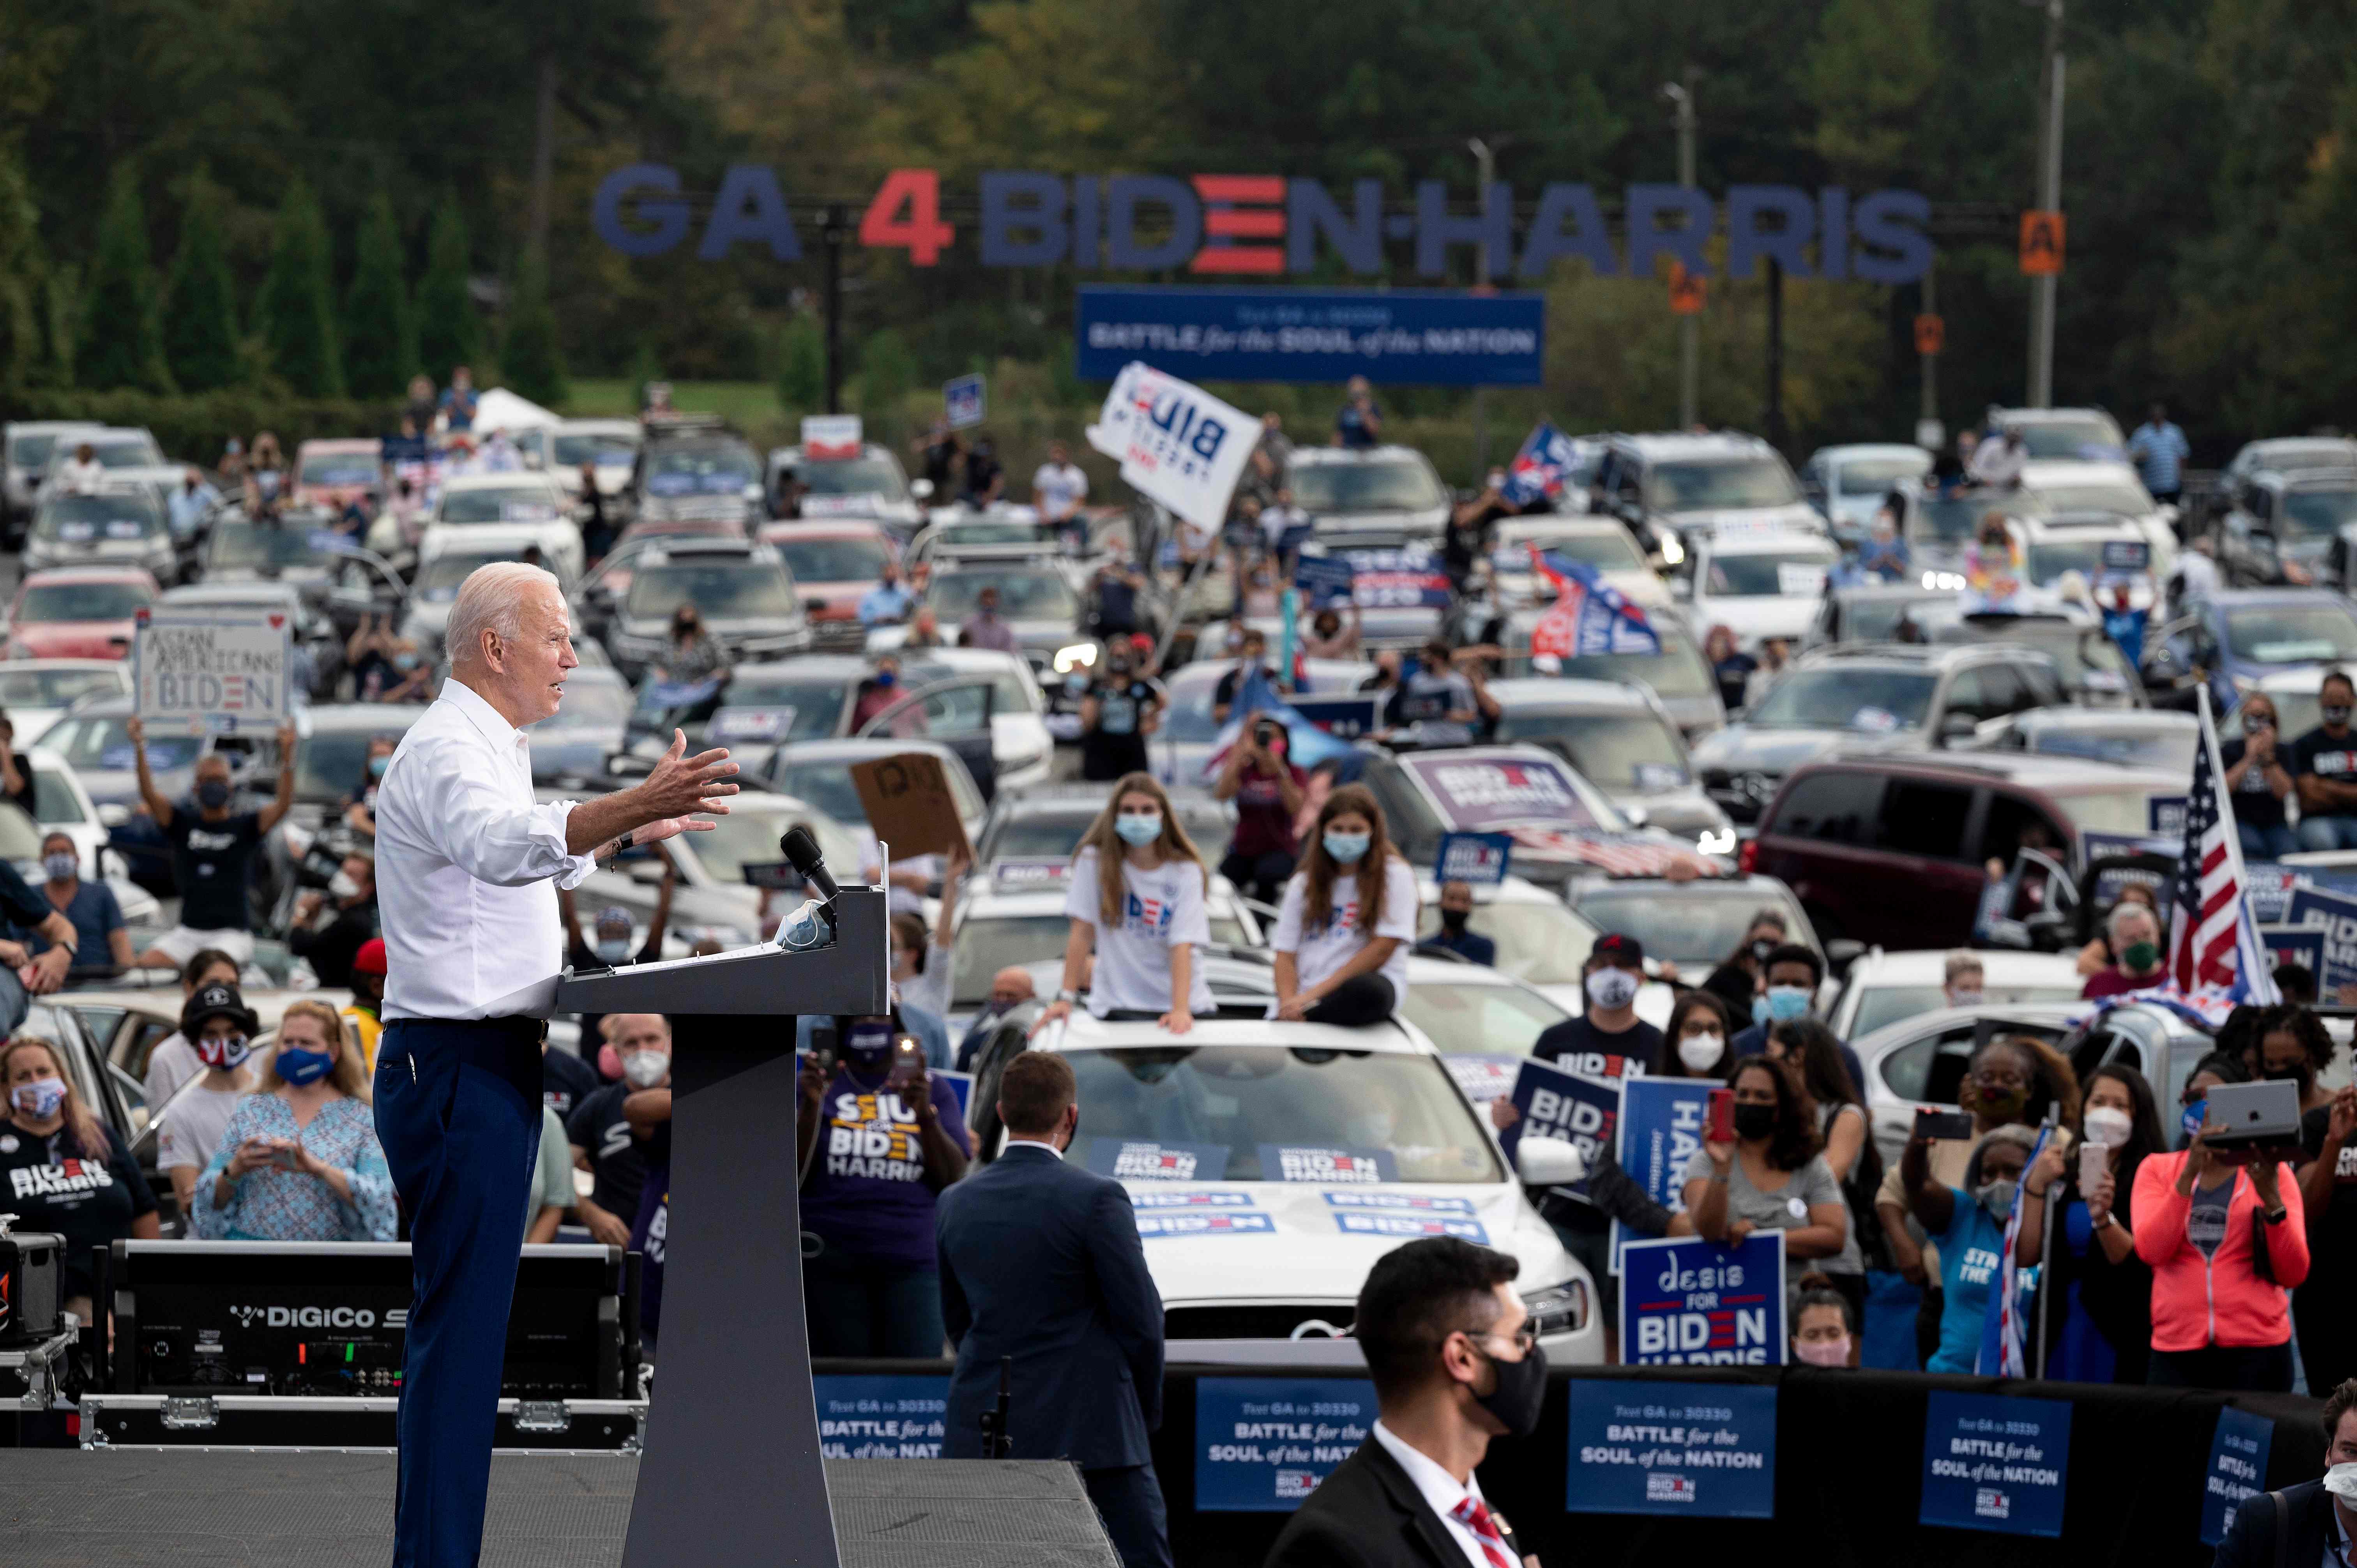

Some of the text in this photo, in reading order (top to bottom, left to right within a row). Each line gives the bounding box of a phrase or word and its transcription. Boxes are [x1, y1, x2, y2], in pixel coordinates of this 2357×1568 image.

[592, 163, 804, 261] GA
[859, 166, 955, 267] 4
[1088, 323, 1200, 351] BATTLE
[1280, 325, 1352, 353] SOUL
[1424, 327, 1536, 355] NATION
[159, 673, 275, 710] BIDEN
[1557, 1053, 1646, 1077] BIDEN
[836, 1093, 917, 1123] SEIU
[829, 1127, 924, 1161] BIDEN
[9, 1158, 104, 1184] BIDEN
[1280, 1154, 1378, 1171] BIDEN
[1343, 1214, 1480, 1237] BIDEN
[1659, 1250, 1745, 1293] desis
[1686, 1292, 1718, 1310] FOR
[268, 1306, 375, 1328] DiGiCo
[1638, 1307, 1767, 1354] BIDEN
[820, 1420, 899, 1437] BATTLE
[898, 1420, 926, 1440] for
[1234, 1423, 1368, 1443] BATTLE for the
[1606, 1425, 1739, 1448] BATTLE for the
[853, 1442, 875, 1459] of
[871, 1443, 897, 1459] the
[899, 1443, 942, 1459] NAT
[1208, 1444, 1264, 1462] SOUL
[1266, 1445, 1286, 1466] of
[1285, 1445, 1312, 1462] the
[1580, 1446, 1763, 1469] SOUL of the NATION
[1951, 1437, 2044, 1462] BATTLE for the
[1931, 1459, 2059, 1486] SOUL of the NATION
